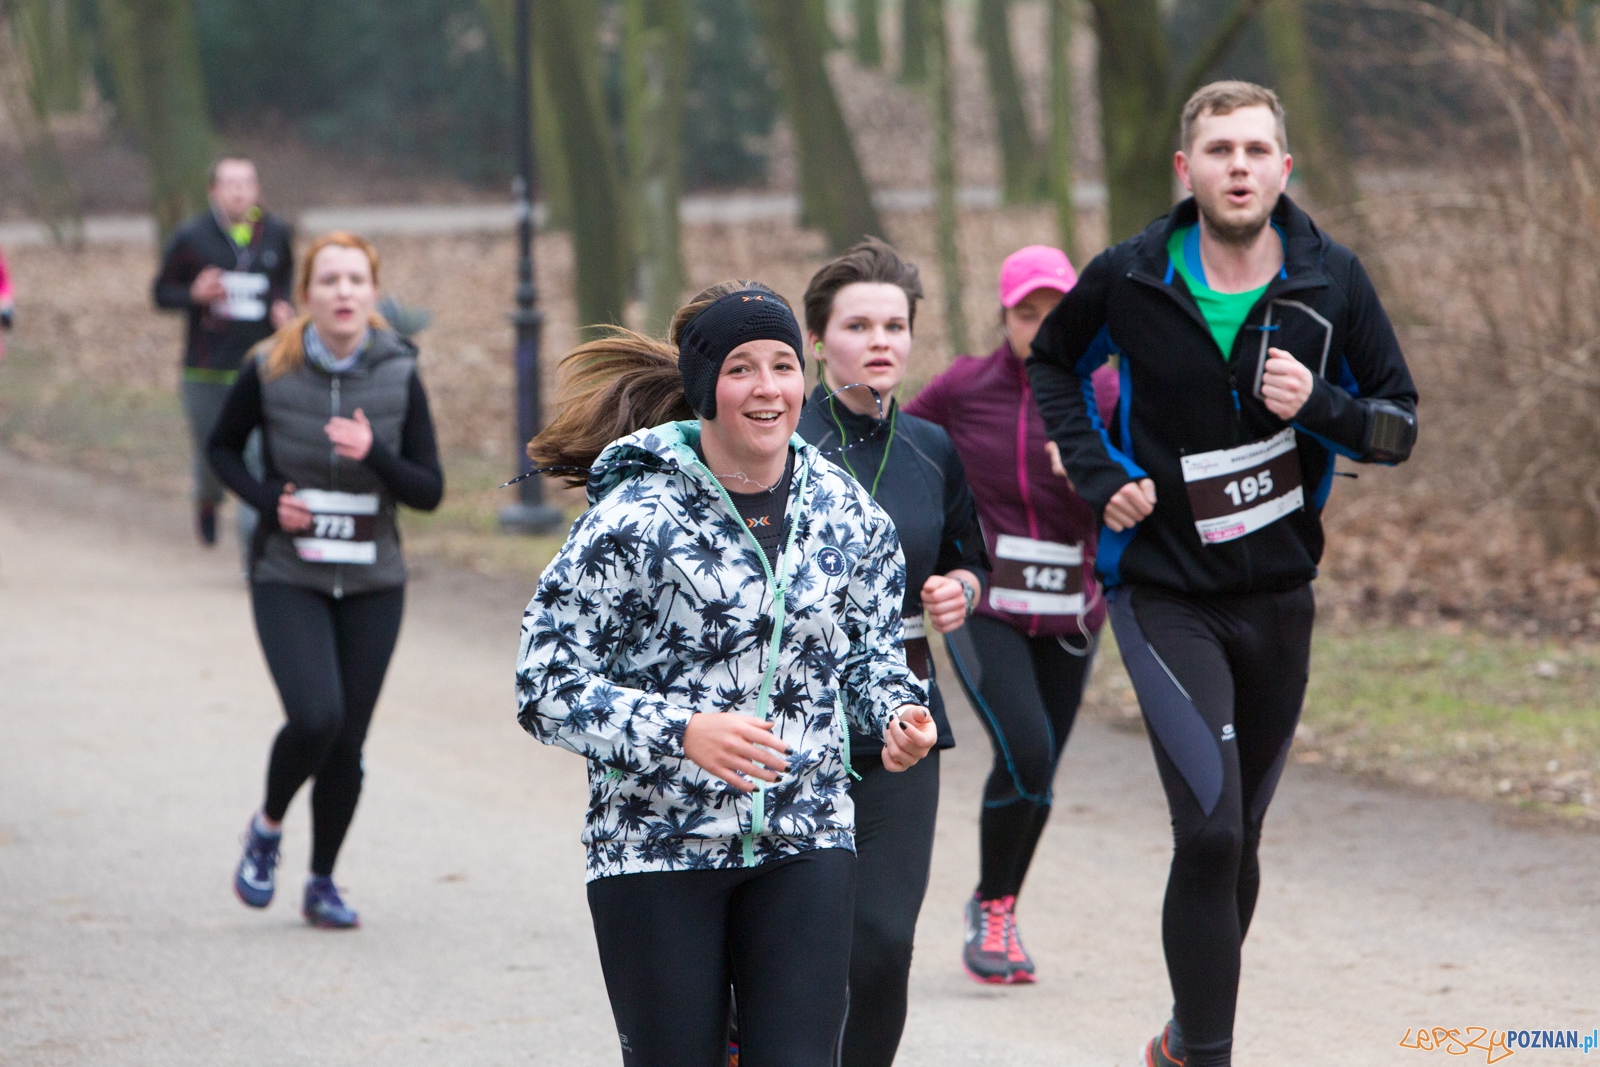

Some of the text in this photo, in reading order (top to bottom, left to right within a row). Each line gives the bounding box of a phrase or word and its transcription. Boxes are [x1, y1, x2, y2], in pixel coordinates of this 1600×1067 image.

[1223, 469, 1274, 507] 195
[313, 514, 355, 540] 773
[1022, 565, 1068, 591] 142
